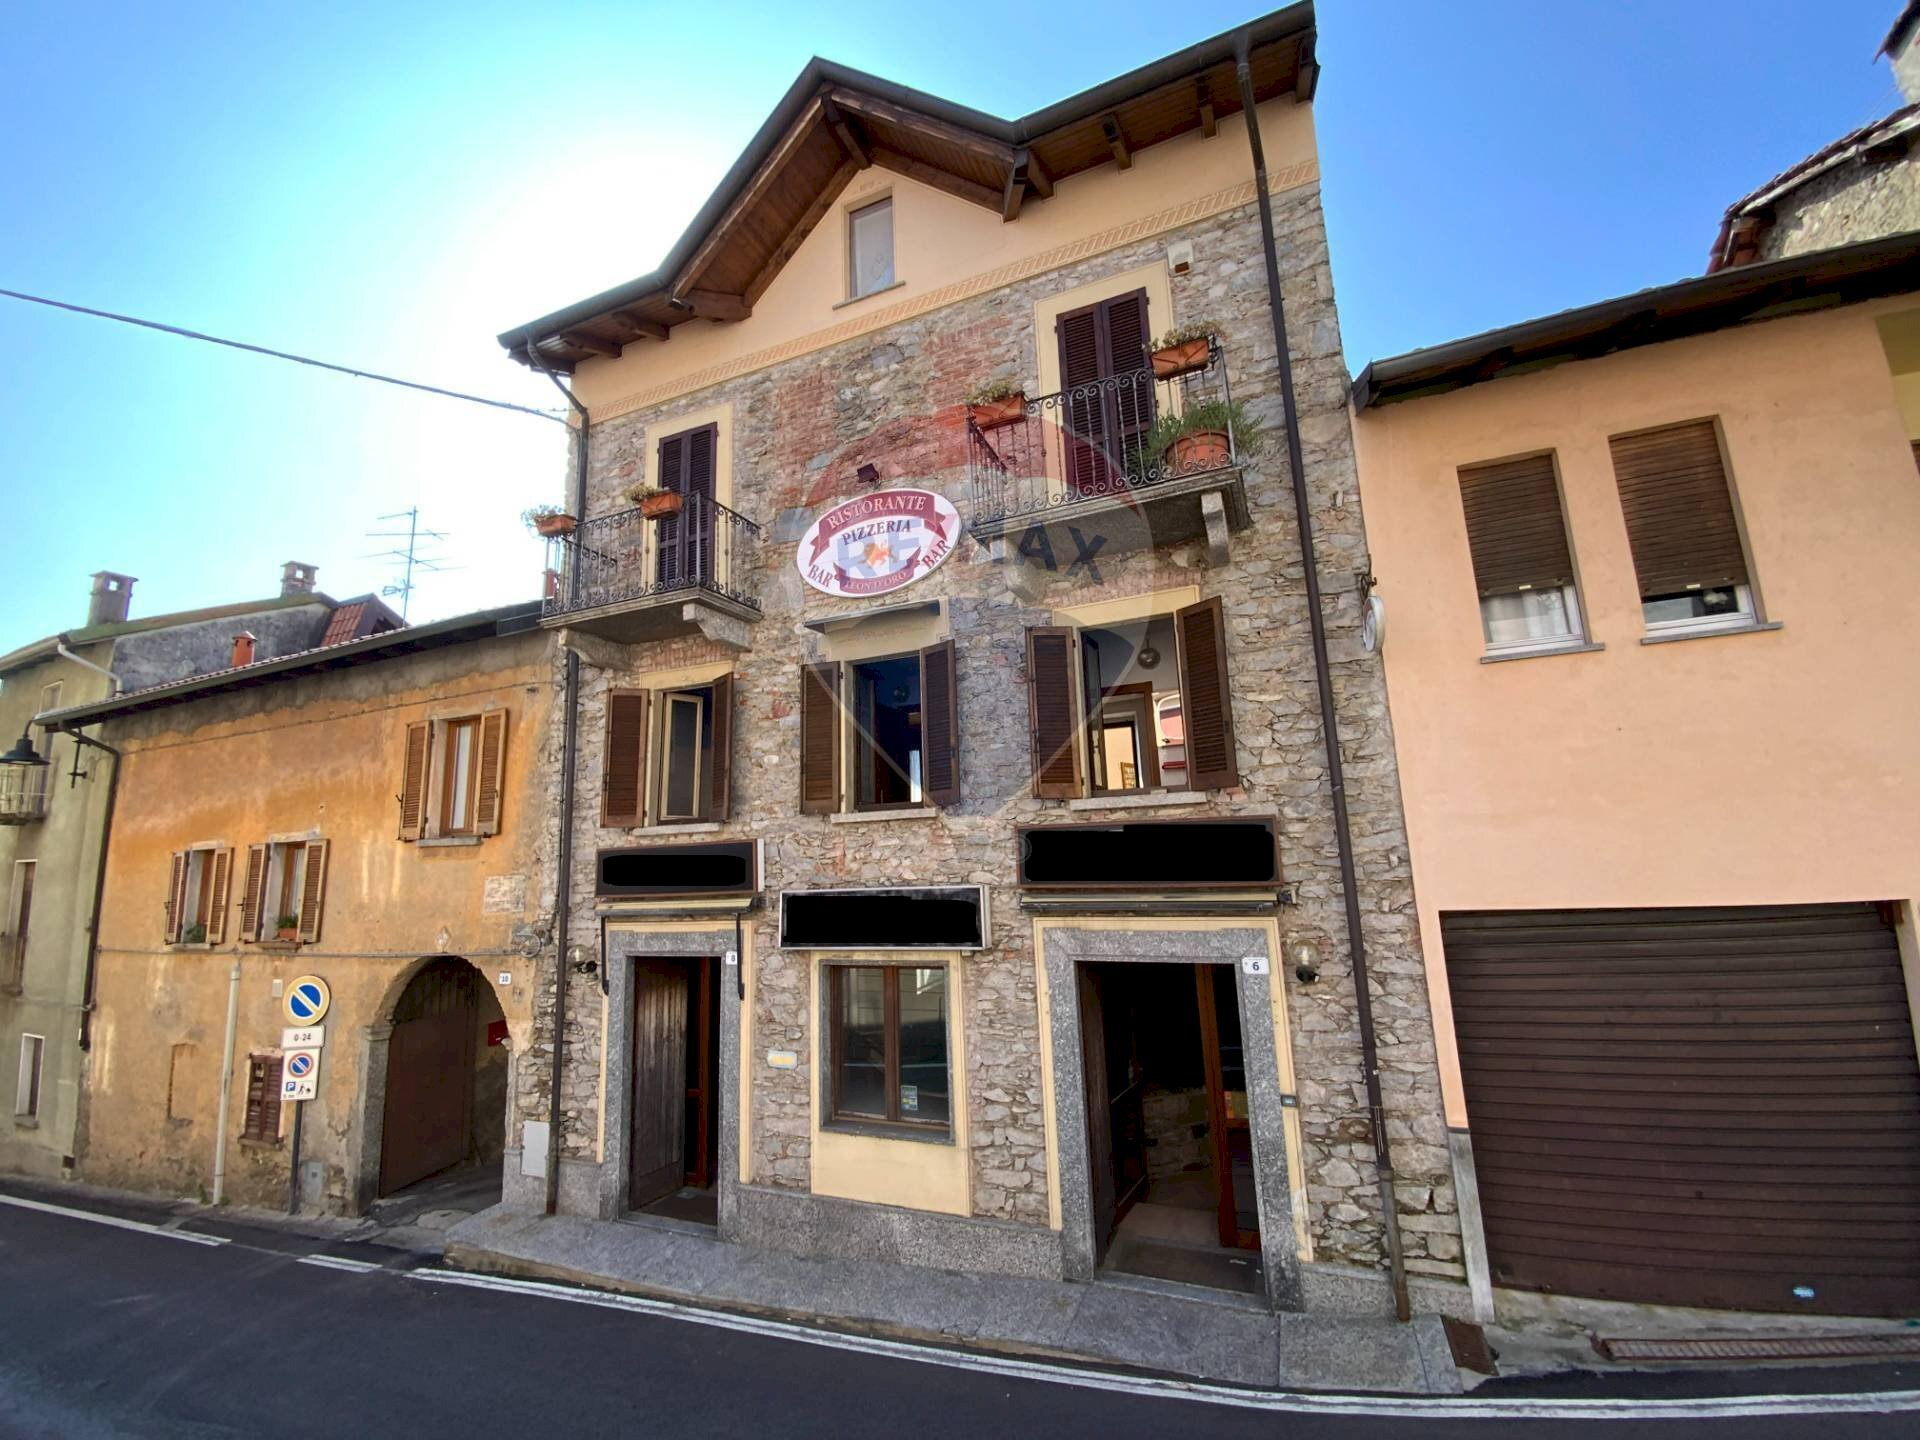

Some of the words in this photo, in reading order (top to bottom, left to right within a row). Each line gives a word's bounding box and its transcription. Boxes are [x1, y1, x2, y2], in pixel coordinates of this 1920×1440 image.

[827, 496, 926, 530] RISTORANTE
[841, 519, 911, 546] PIZZERIA
[922, 539, 951, 570] BAR
[807, 564, 834, 588] BAR
[1252, 961, 1260, 971] 6
